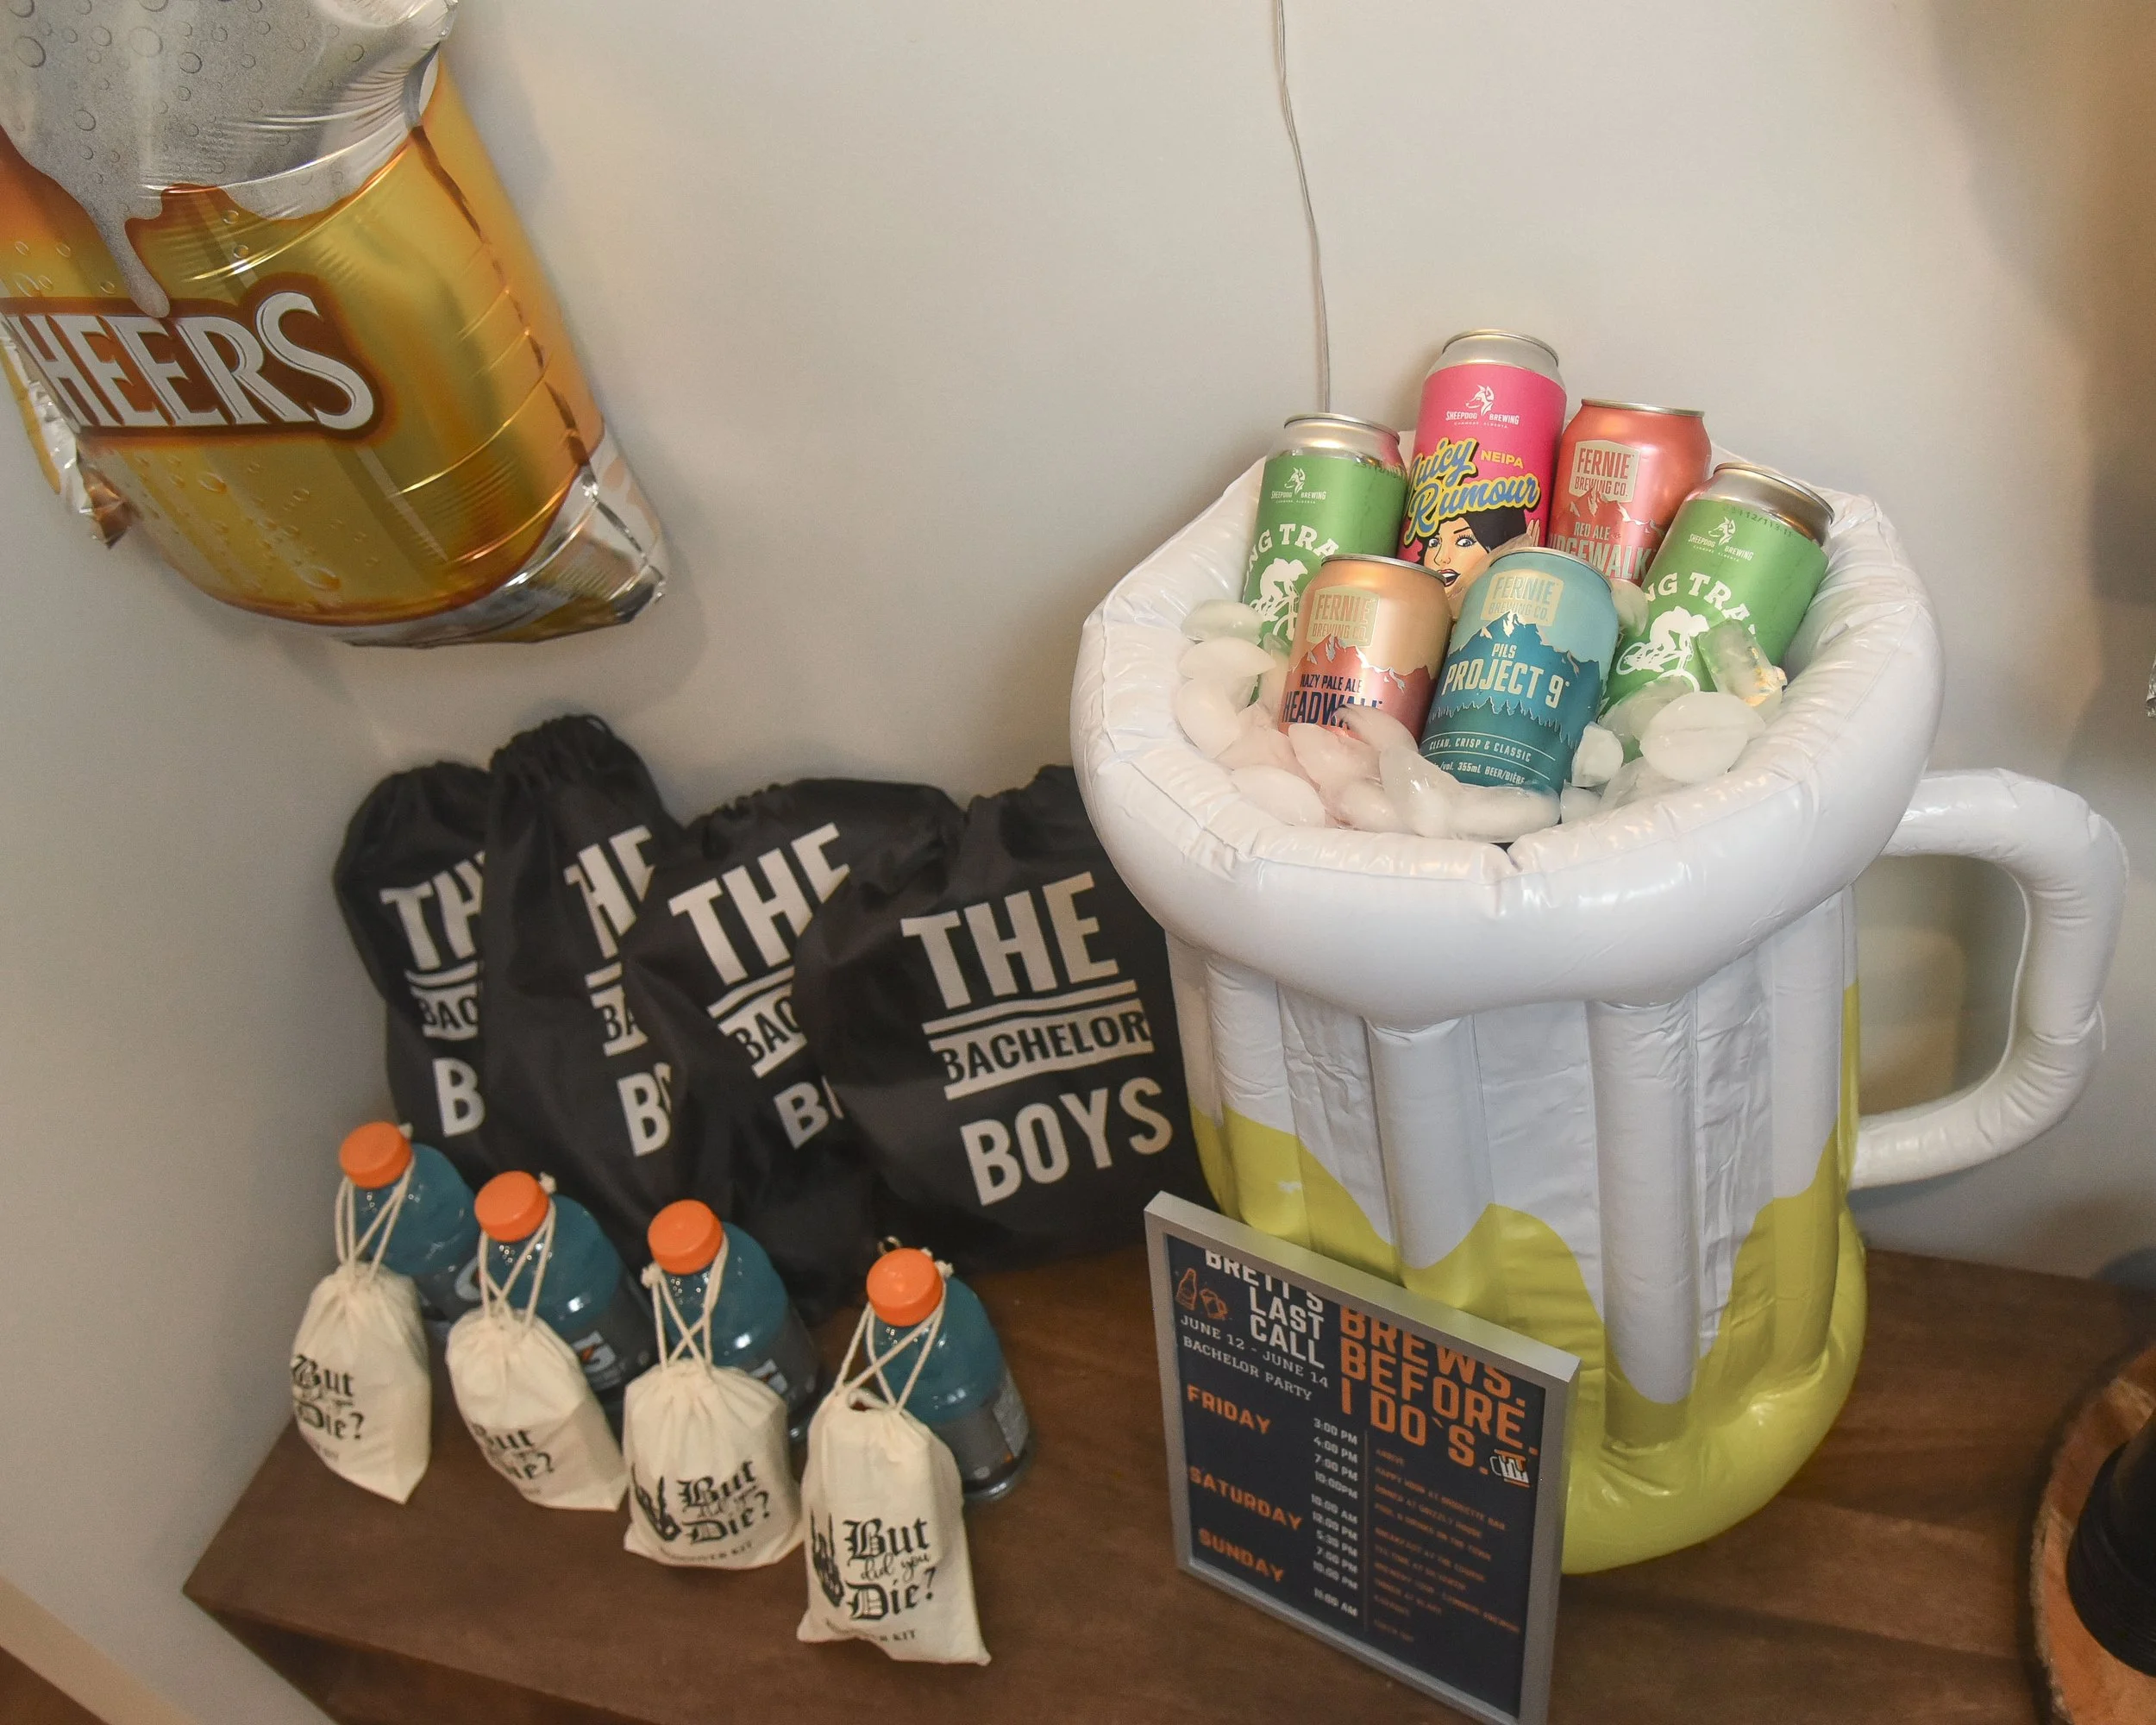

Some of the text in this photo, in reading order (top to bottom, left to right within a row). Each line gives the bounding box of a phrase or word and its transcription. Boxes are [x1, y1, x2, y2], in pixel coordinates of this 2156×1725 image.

[3, 291, 373, 431] HEERS
[1445, 411, 1520, 425] SHEEPDOG BREWING
[1480, 450, 1524, 469] NEIPA
[1577, 448, 1631, 479] FERNIE
[1300, 491, 1326, 500] BREWING
[1575, 476, 1628, 497] BREWING CO.
[1404, 474, 1540, 547] Rumour
[1574, 521, 1611, 541] RED ALE
[1725, 545, 1754, 561] BREWING
[1315, 593, 1370, 624] FERNIE
[1489, 602, 1532, 616] BREWING
[1493, 575, 1555, 605] FERNIE
[1312, 623, 1350, 639] BREWING
[1492, 643, 1517, 658] PILS
[1322, 675, 1344, 690] PALE
[1344, 677, 1363, 693] ALE
[1441, 658, 1544, 699] PROJECT
[1282, 691, 1378, 728] HEADW
[1455, 737, 1481, 749] CRISP
[1483, 741, 1490, 750] &
[1494, 742, 1532, 762] CLASSIC
[668, 822, 850, 985] THE
[900, 870, 1120, 1010] THE
[944, 1011, 1150, 1084] BACHELOR
[960, 1076, 1174, 1207] BOYS
[1205, 1249, 1324, 1314] BRES
[1250, 1285, 1324, 1340] LAST
[1181, 1314, 1221, 1340] JUNE
[1226, 1333, 1245, 1351] 12
[1263, 1350, 1304, 1377] JUNE
[1310, 1371, 1329, 1389] 14
[1250, 1314, 1325, 1370] CALL
[1340, 1306, 1526, 1408] BREWS.
[1182, 1335, 1313, 1401] BACHELOR PARTY
[1187, 1383, 1271, 1435] FRIDAY
[1340, 1337, 1539, 1456] BEFORE.
[1341, 1377, 1351, 1415] I
[1340, 1429, 1358, 1446] PM
[1341, 1446, 1358, 1464] PM
[676, 1459, 757, 1513] But
[1341, 1465, 1358, 1482] PM
[681, 1489, 770, 1545] Die?
[1188, 1465, 1304, 1532] SATURDAY
[842, 1517, 931, 1567] But
[1198, 1527, 1286, 1584] SUNDAY
[844, 1565, 938, 1621] Die?
